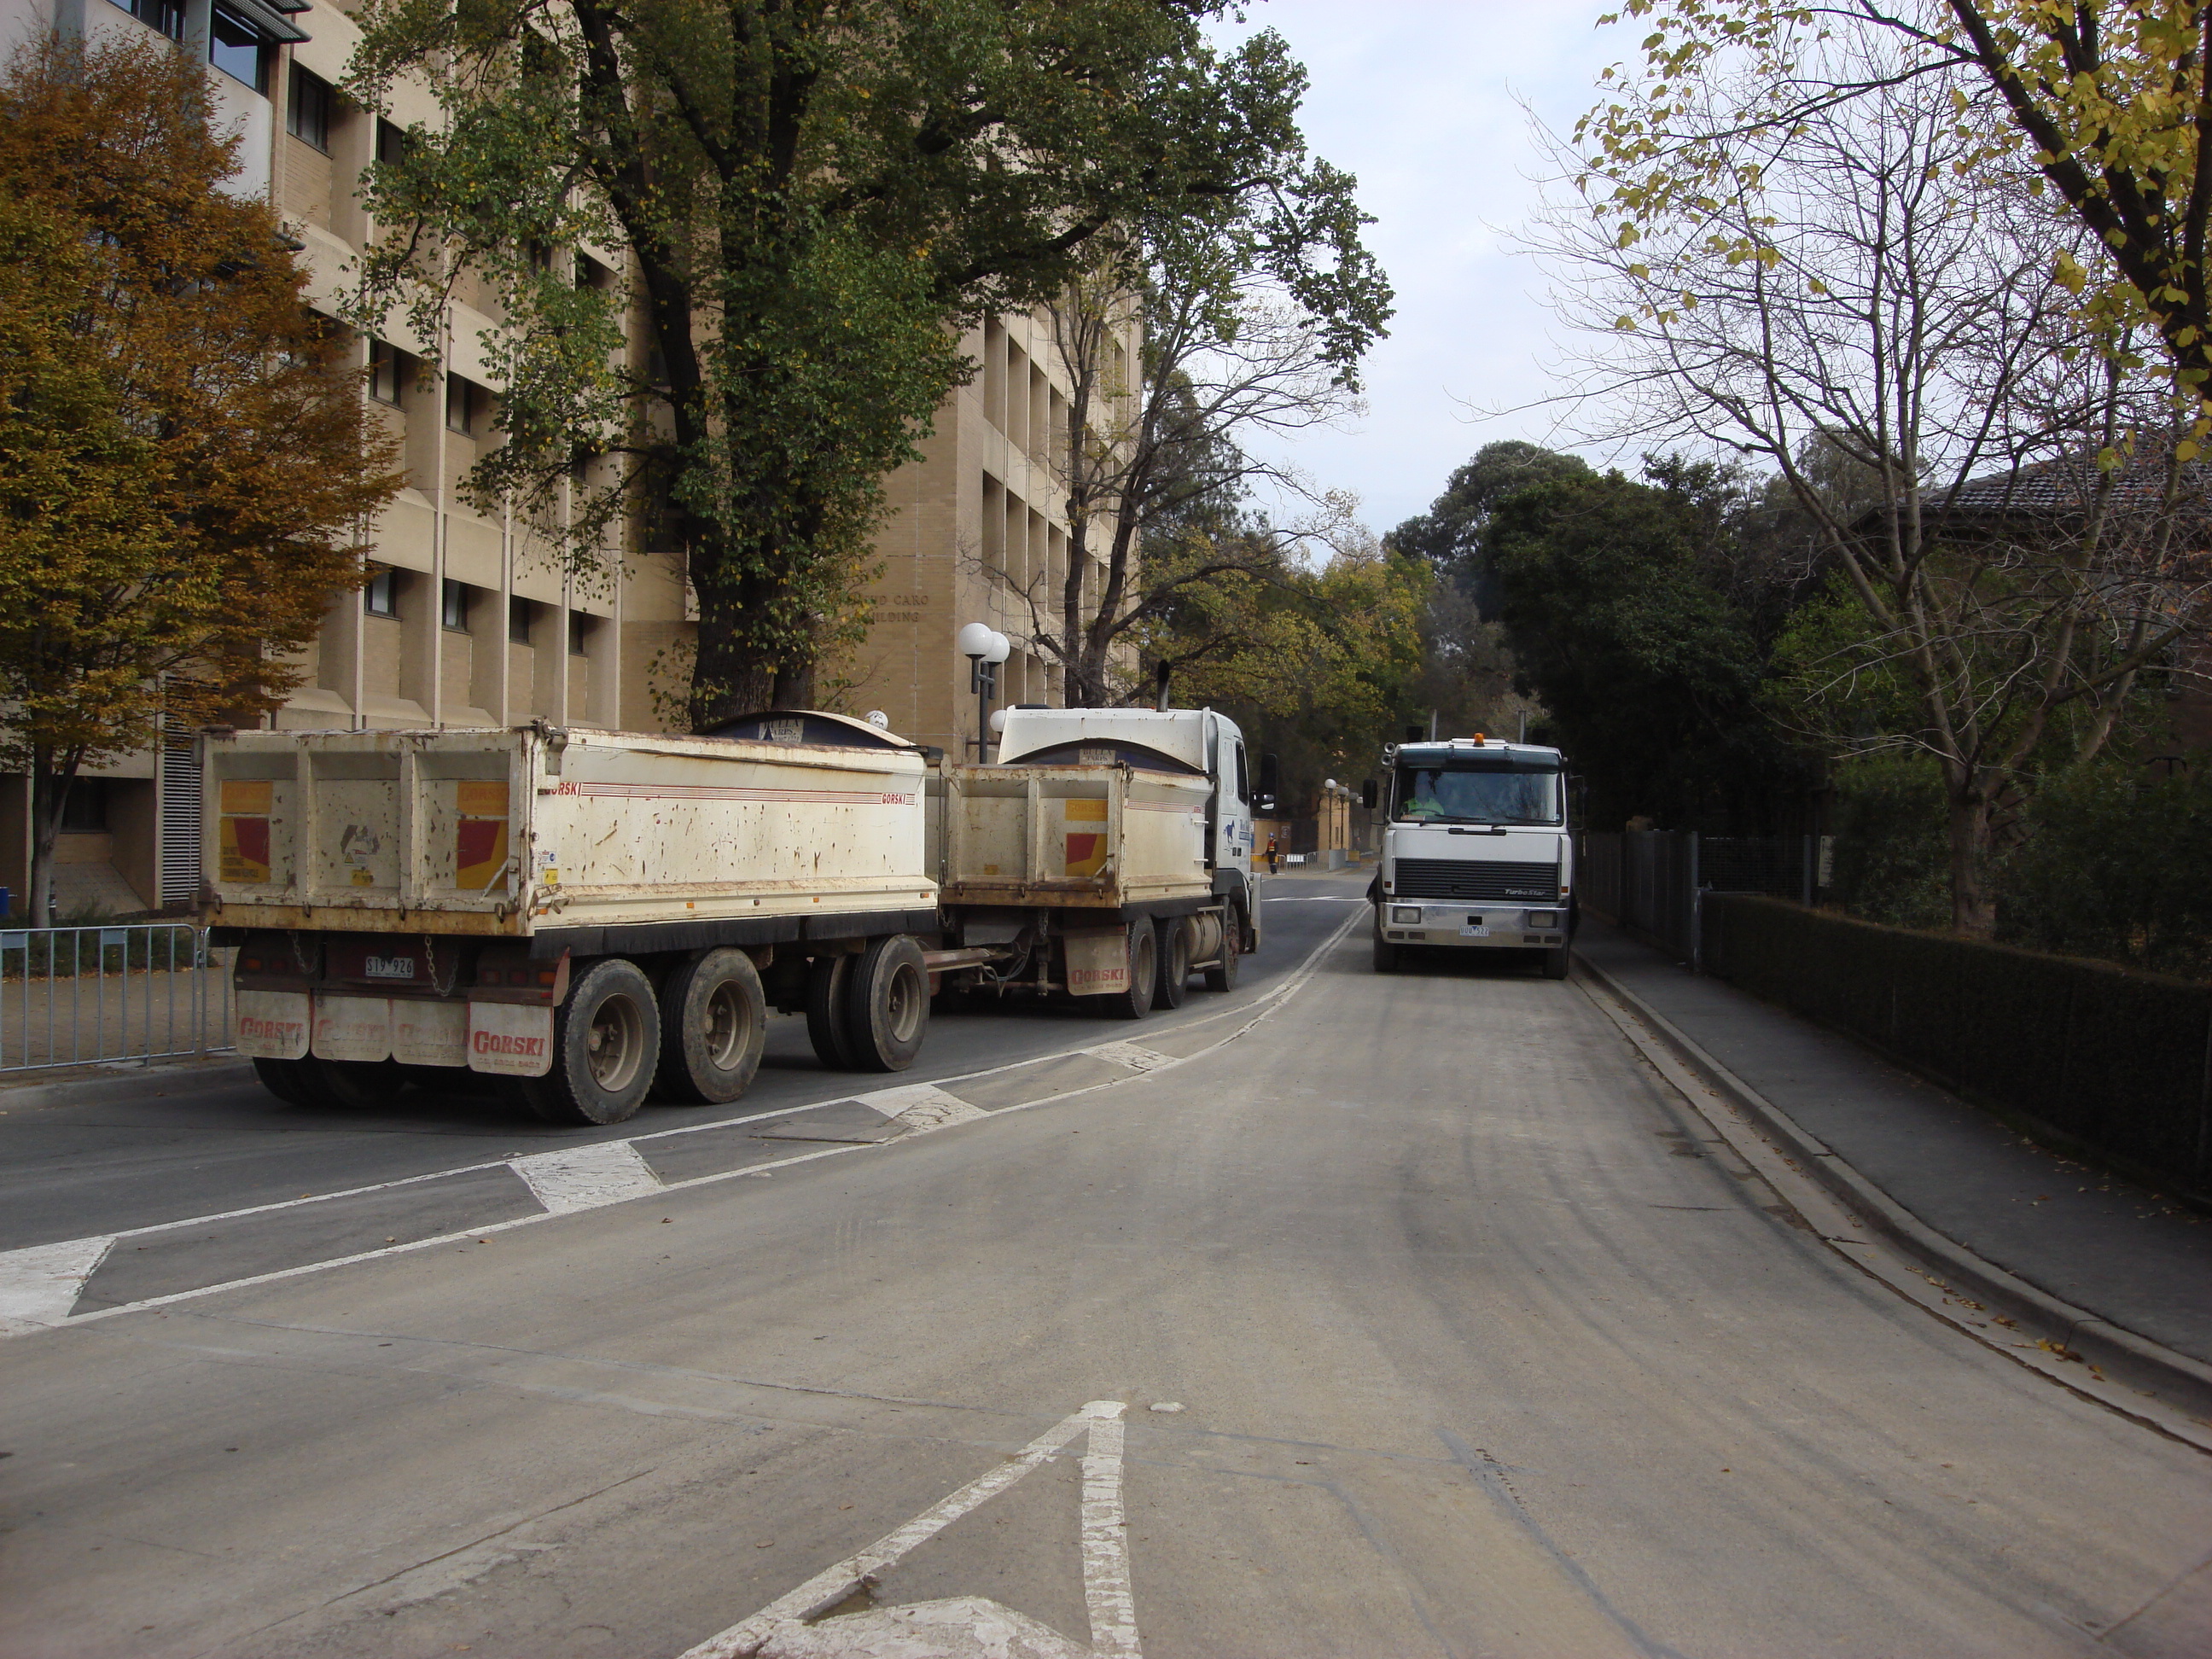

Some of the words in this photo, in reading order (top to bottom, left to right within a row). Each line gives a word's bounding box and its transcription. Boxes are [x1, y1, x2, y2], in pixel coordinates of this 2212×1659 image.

[872, 612, 920, 622] ILDING
[882, 794, 906, 806] GORSKI
[1071, 968, 1125, 985] GORSKI
[474, 1030, 545, 1056] GORSKI
